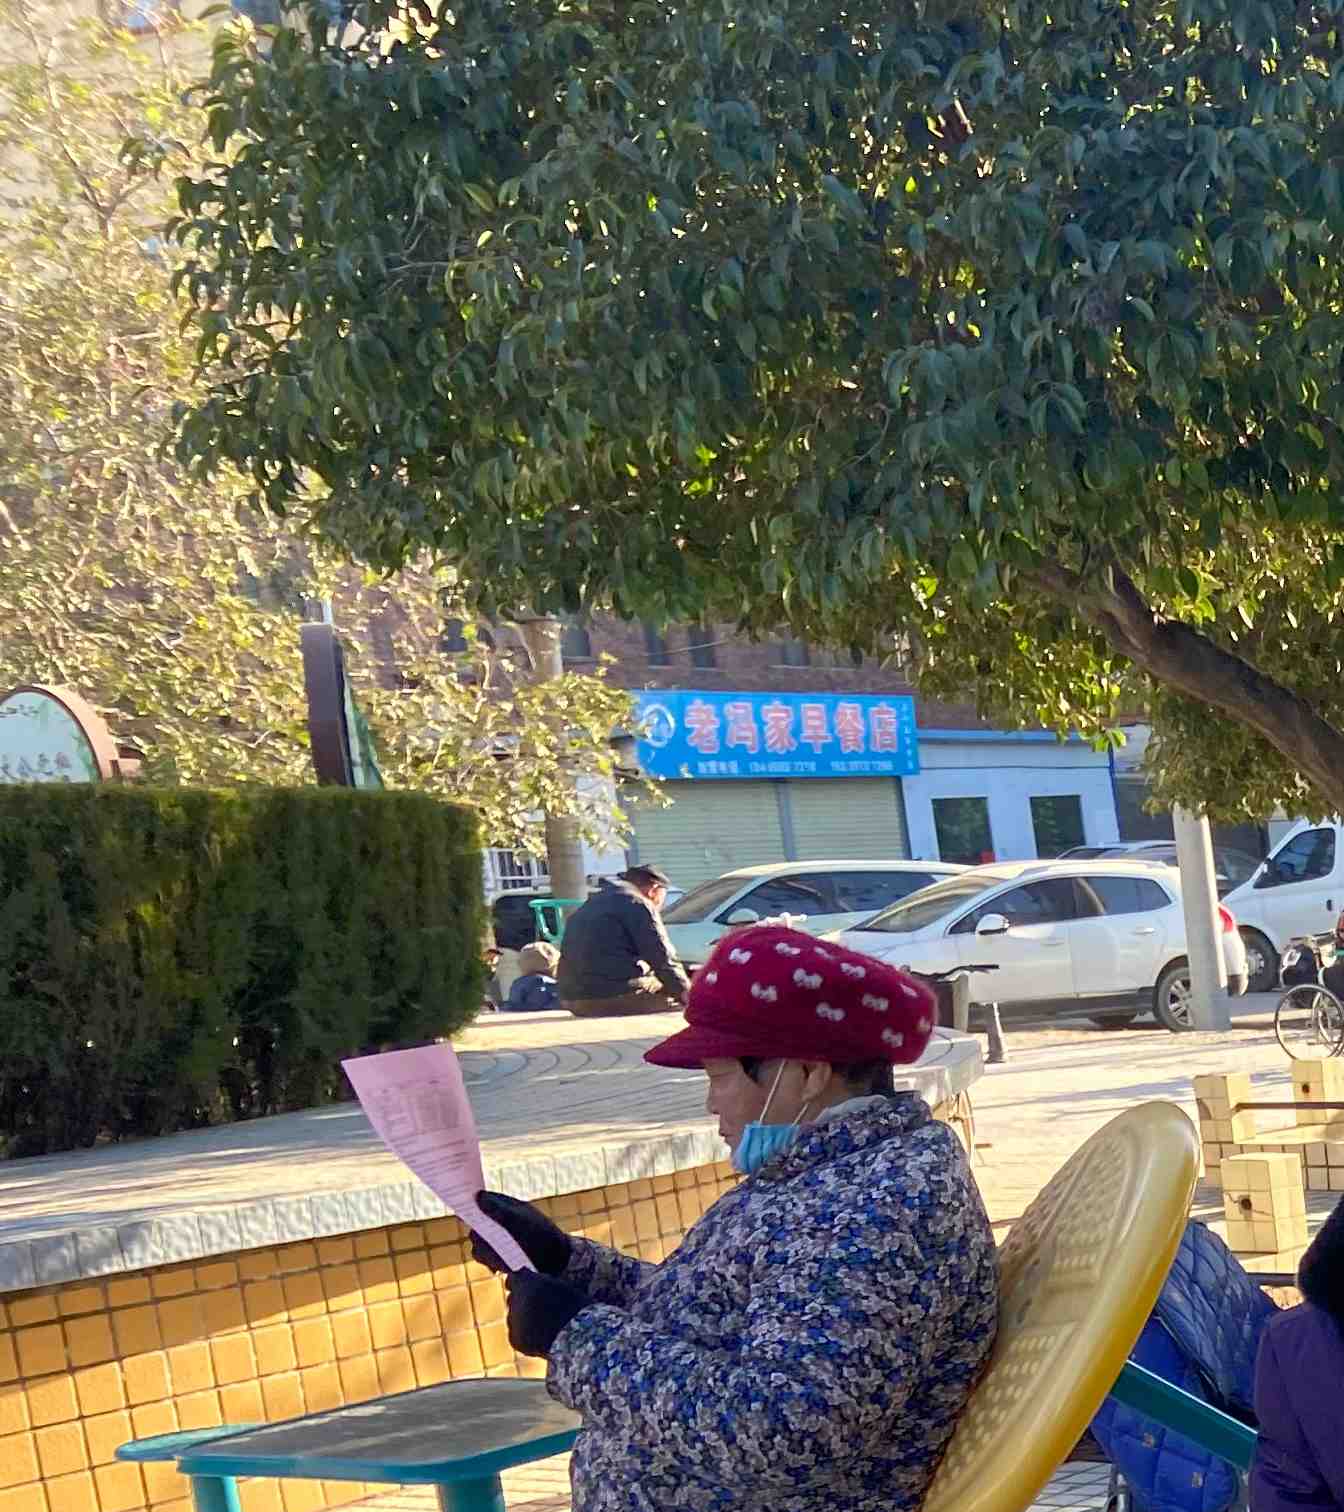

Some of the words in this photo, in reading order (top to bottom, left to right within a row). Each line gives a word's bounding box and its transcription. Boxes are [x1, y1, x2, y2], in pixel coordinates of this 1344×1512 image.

[683, 697, 899, 754] 老冯家早餐店
